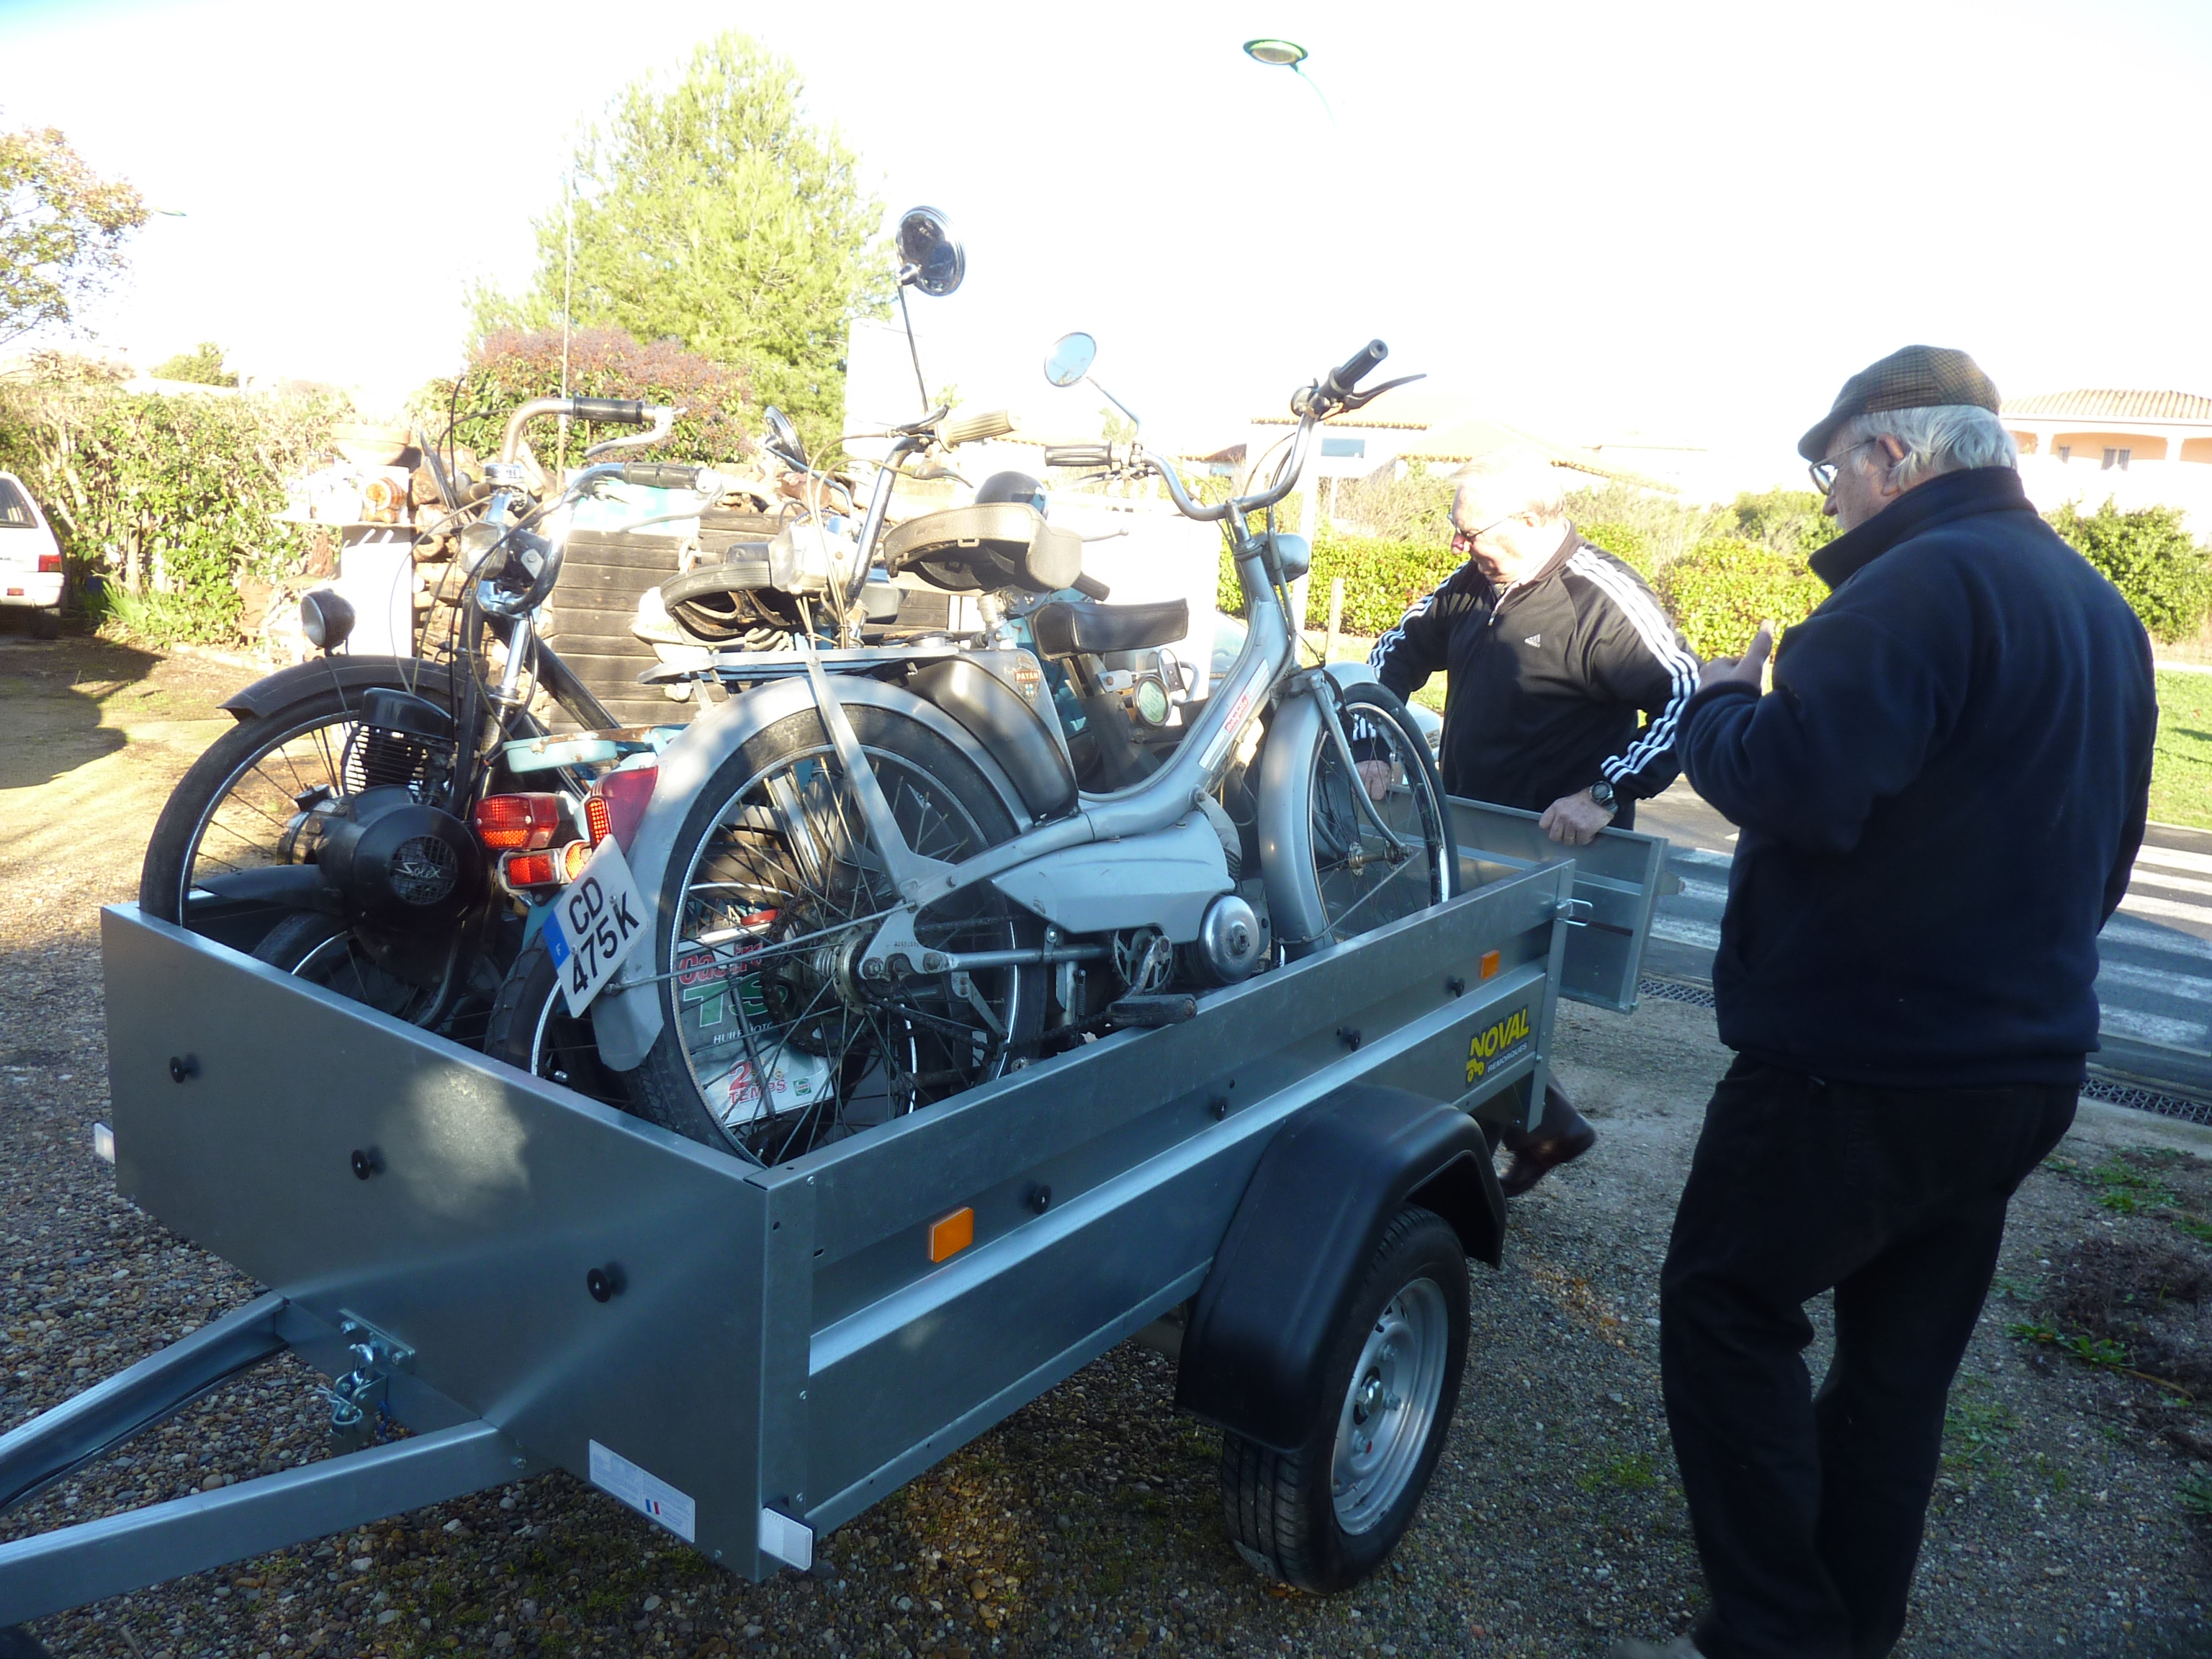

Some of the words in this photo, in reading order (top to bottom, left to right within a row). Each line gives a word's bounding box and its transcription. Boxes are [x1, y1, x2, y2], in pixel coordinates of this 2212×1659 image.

[1016, 672, 1038, 680] PAYAN
[569, 876, 603, 935] CD
[555, 943, 562, 956] F
[571, 914, 618, 994] 475
[613, 891, 640, 940] K
[1470, 1008, 1529, 1057] NOVAL
[729, 1059, 752, 1091] 2
